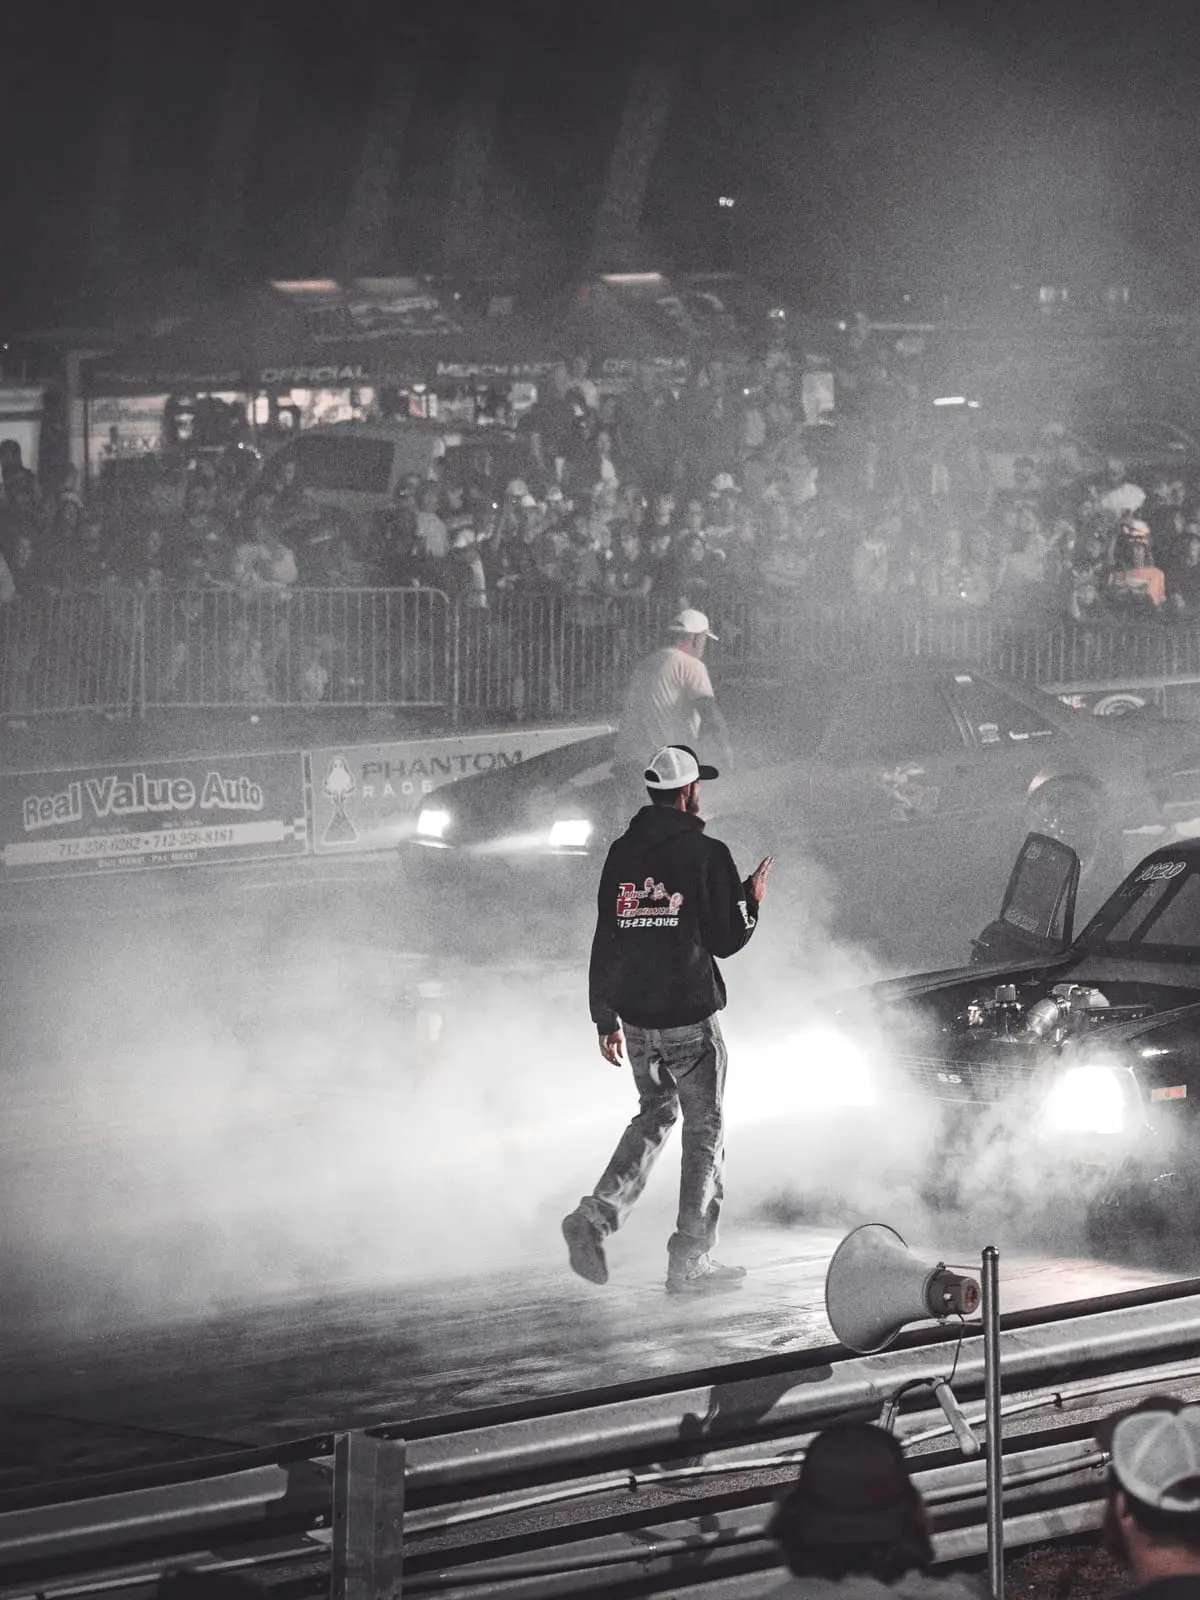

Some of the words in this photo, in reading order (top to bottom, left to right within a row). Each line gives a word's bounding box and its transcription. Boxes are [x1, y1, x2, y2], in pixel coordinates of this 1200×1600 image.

[23, 781, 83, 832] Real
[86, 772, 196, 817] Value
[200, 771, 264, 811] Auto
[1134, 861, 1187, 883] 1820
